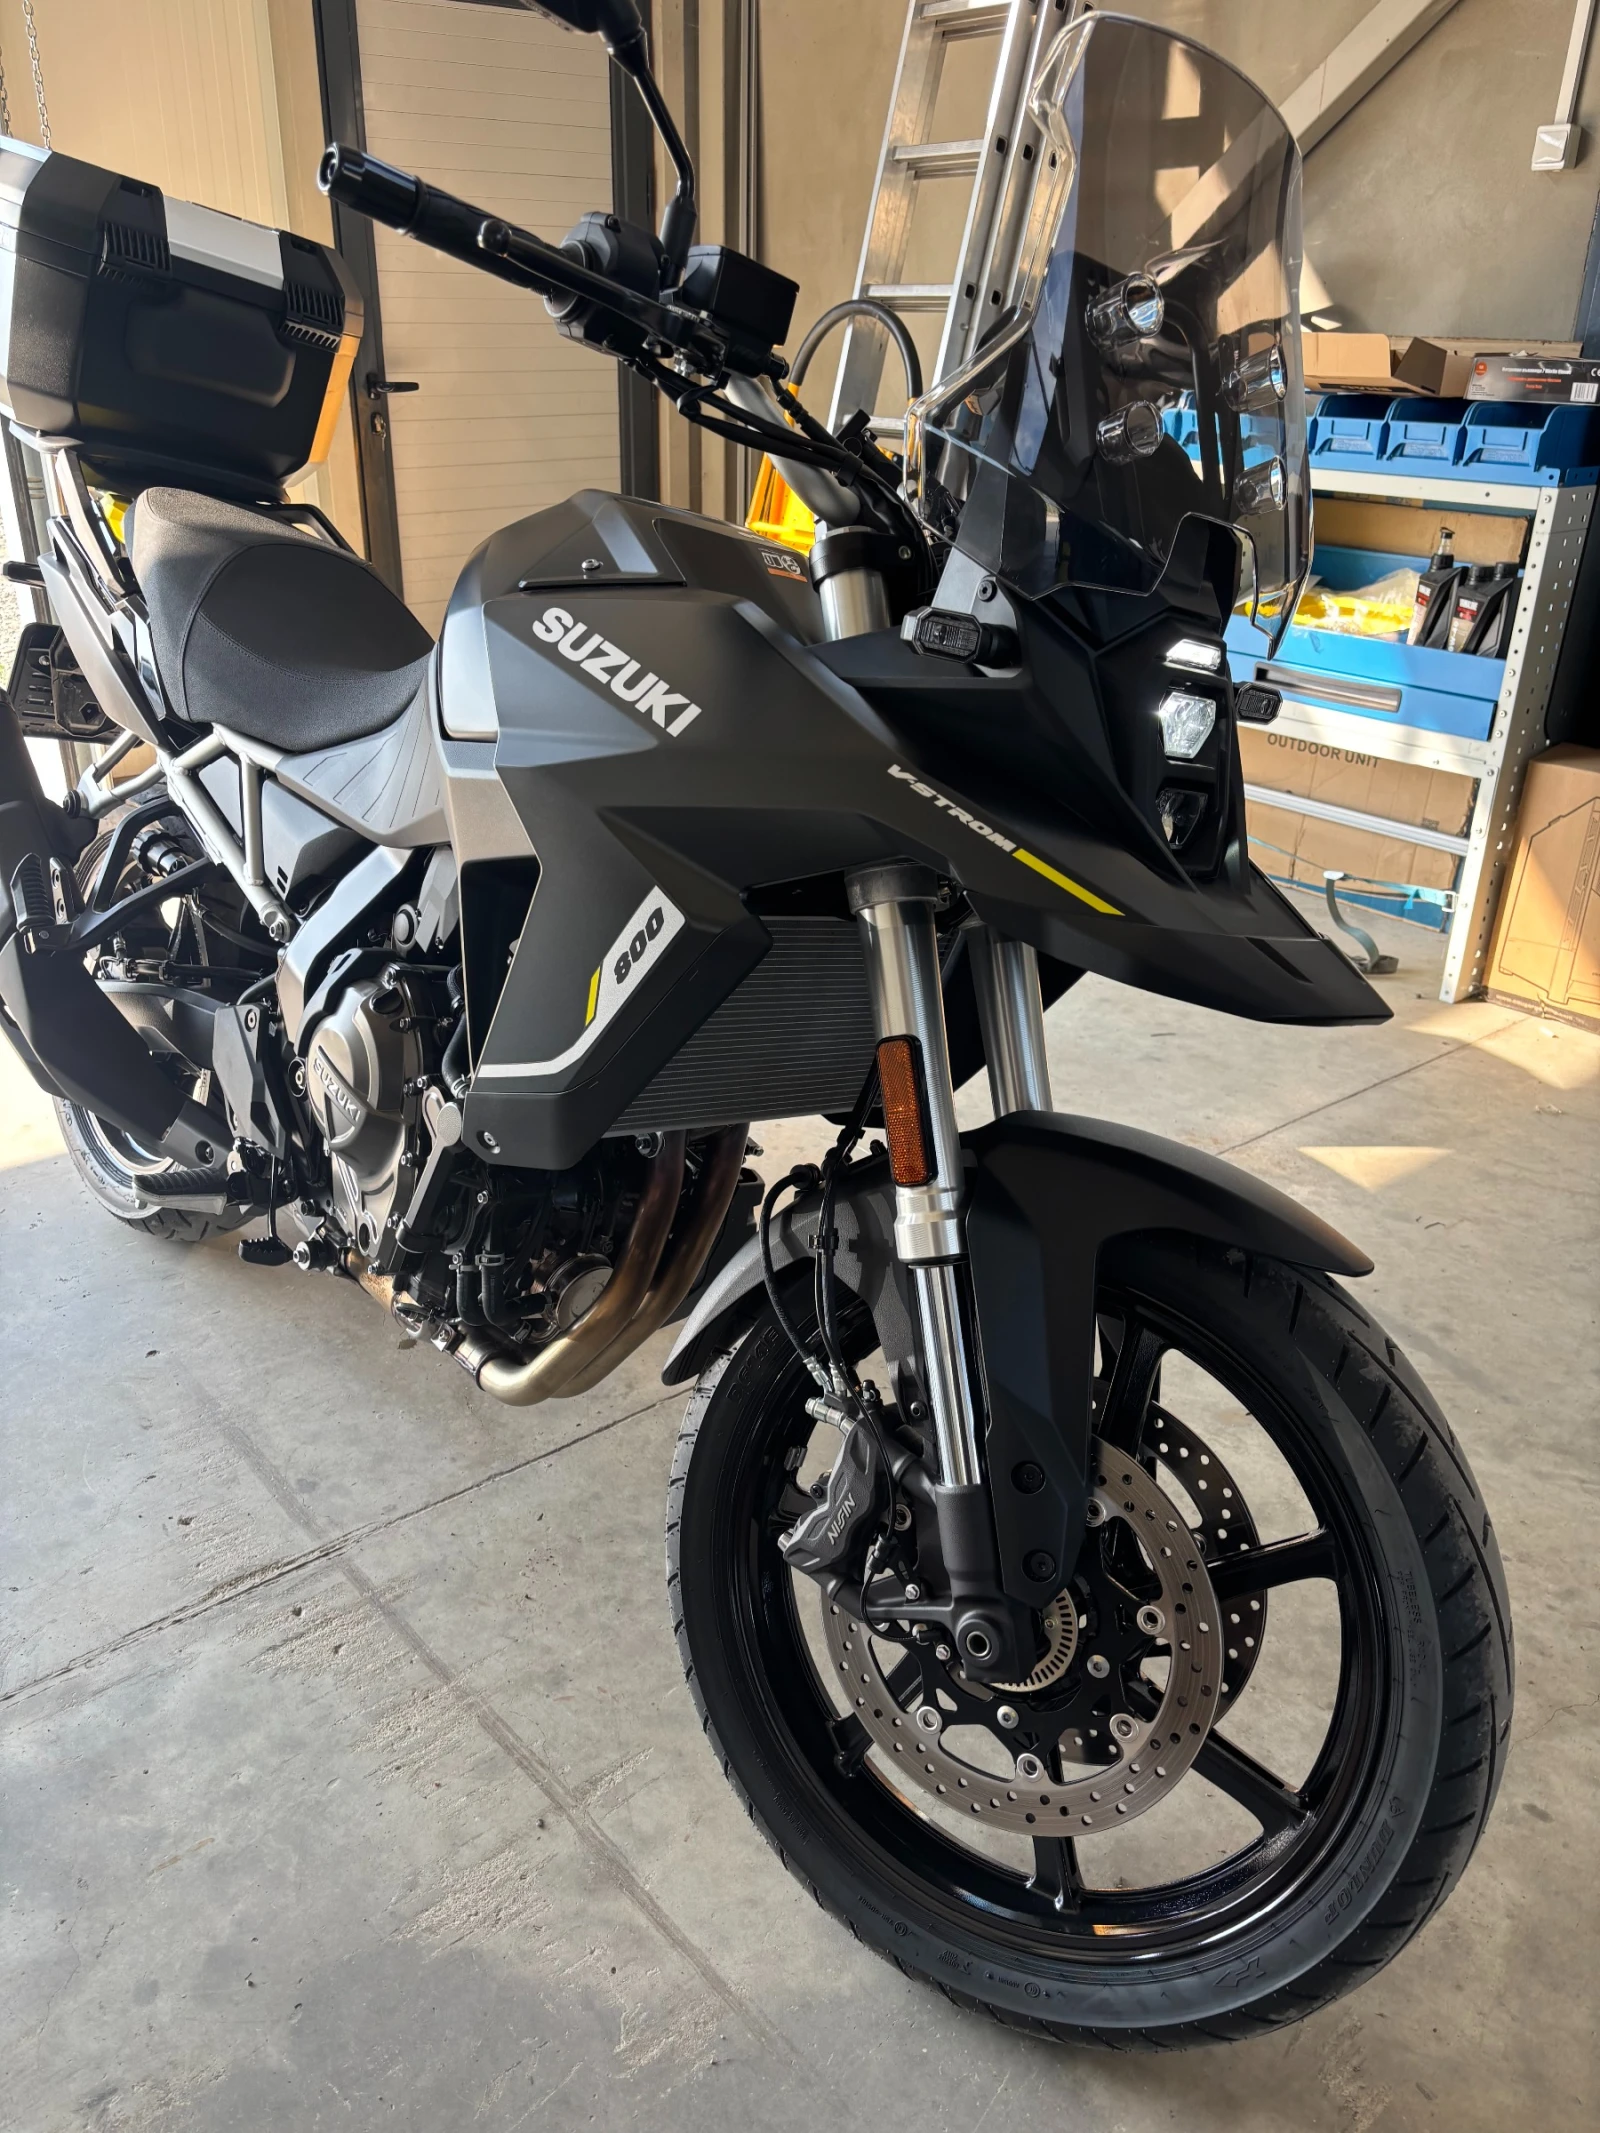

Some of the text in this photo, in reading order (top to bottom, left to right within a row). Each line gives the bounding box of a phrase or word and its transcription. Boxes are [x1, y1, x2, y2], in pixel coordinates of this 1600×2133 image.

[532, 607, 702, 738] SUZUKI
[1267, 733, 1380, 768] OUTDOOR UNIT
[887, 764, 1017, 852] V-STROM
[614, 906, 664, 985] 800
[314, 1058, 361, 1122] SUZUKI
[827, 1492, 856, 1545] NISSIN
[1324, 1818, 1395, 1926] DUNLOP
